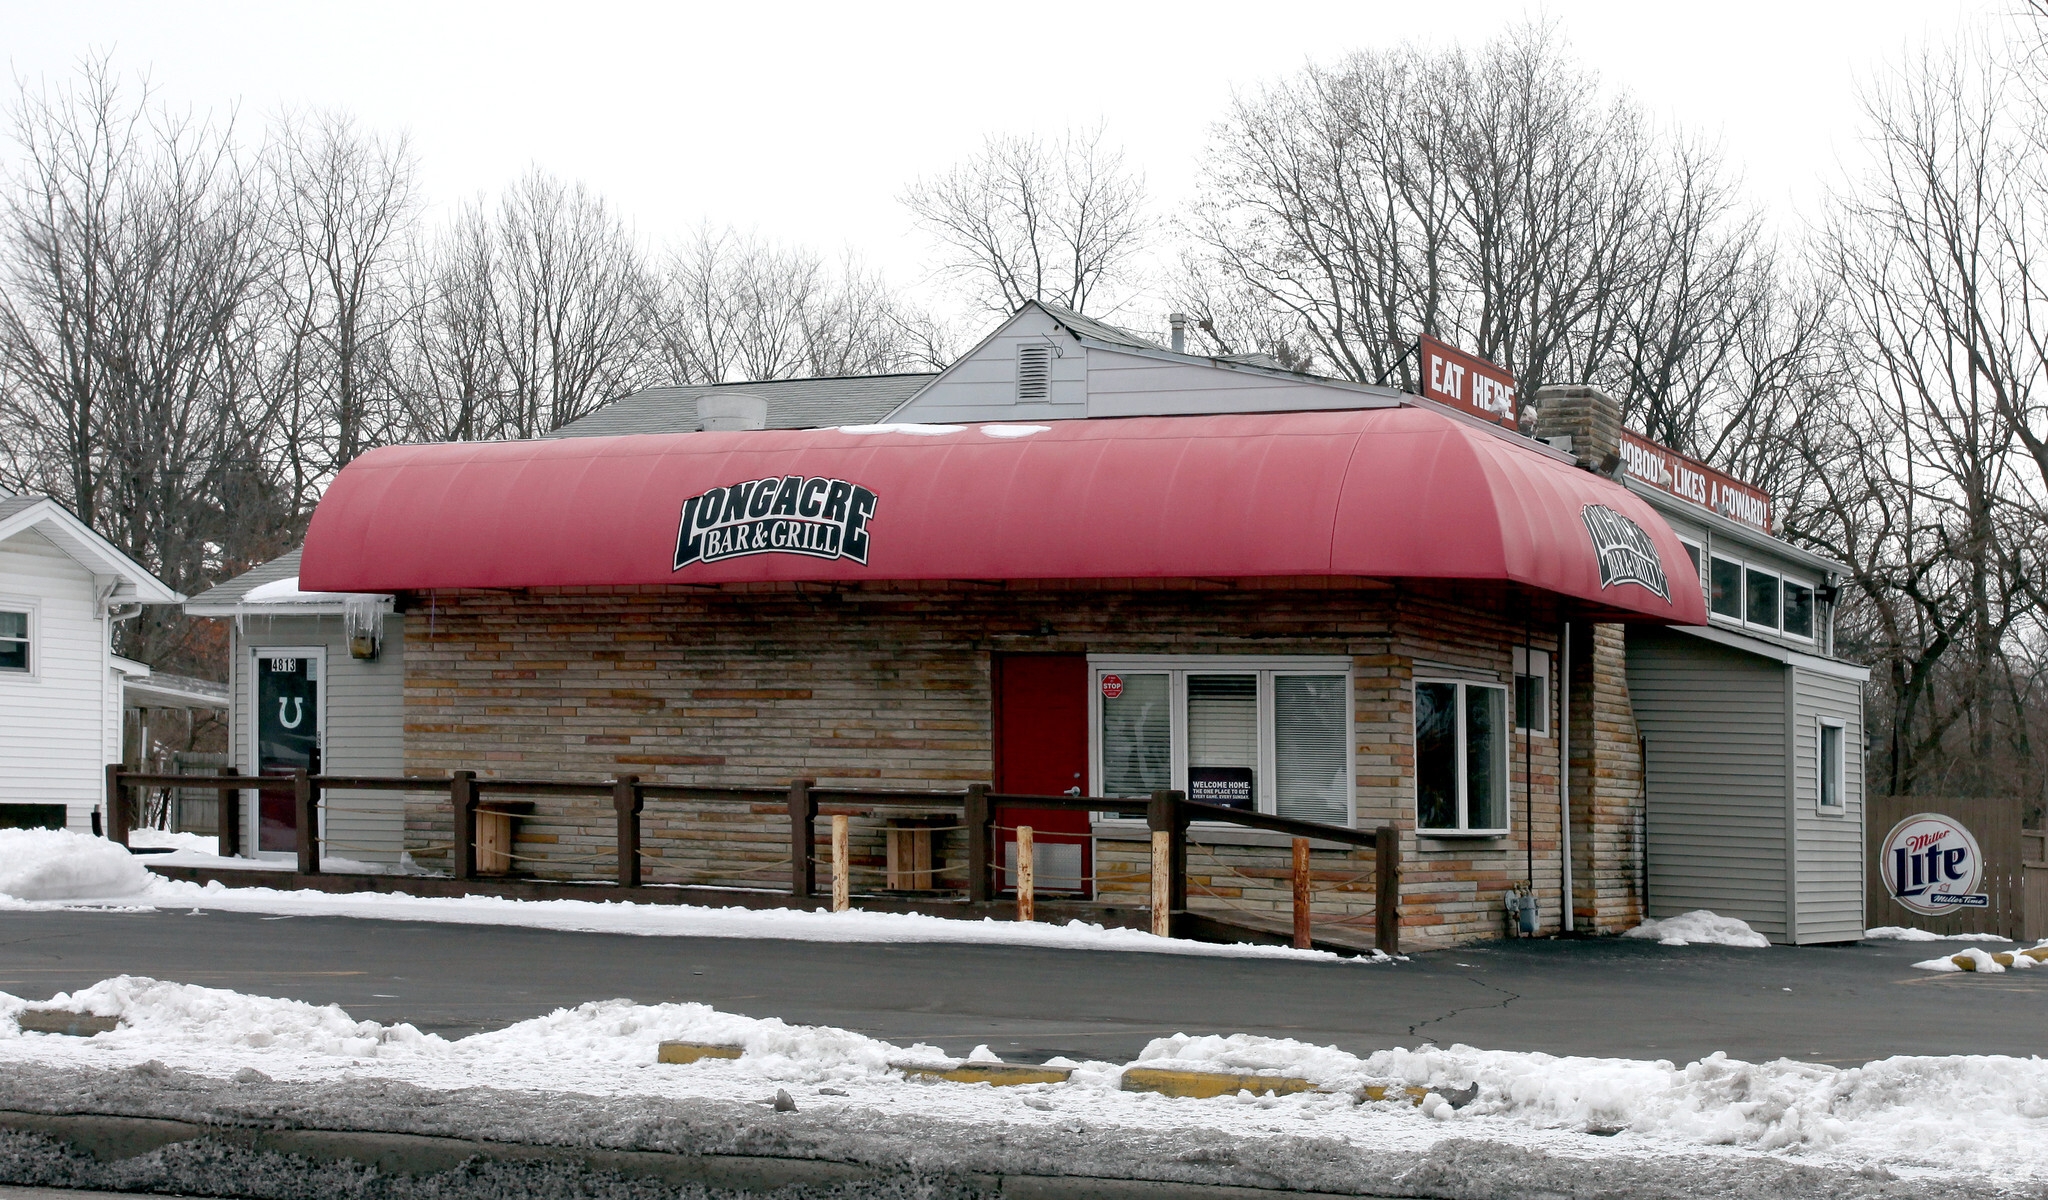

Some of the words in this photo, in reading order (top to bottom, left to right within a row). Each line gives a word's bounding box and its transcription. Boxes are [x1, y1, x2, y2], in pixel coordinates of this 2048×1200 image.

[1431, 354, 1465, 400] EAT
[1472, 371, 1515, 421] HERE
[1619, 438, 1665, 484] NOBODY
[1673, 464, 1706, 504] LIKES
[1710, 480, 1724, 508] A
[1721, 484, 1767, 529] COWARD!
[672, 474, 878, 573] LONGACRE
[272, 658, 296, 672] 4813
[1103, 682, 1121, 690] STOP
[1192, 781, 1228, 789] WELCOME
[1228, 781, 1251, 789] HOME.
[1905, 829, 1951, 853] Miller
[1893, 843, 1968, 898] Lite
[1932, 894, 1963, 904] Miller
[1961, 896, 1985, 905] Time
